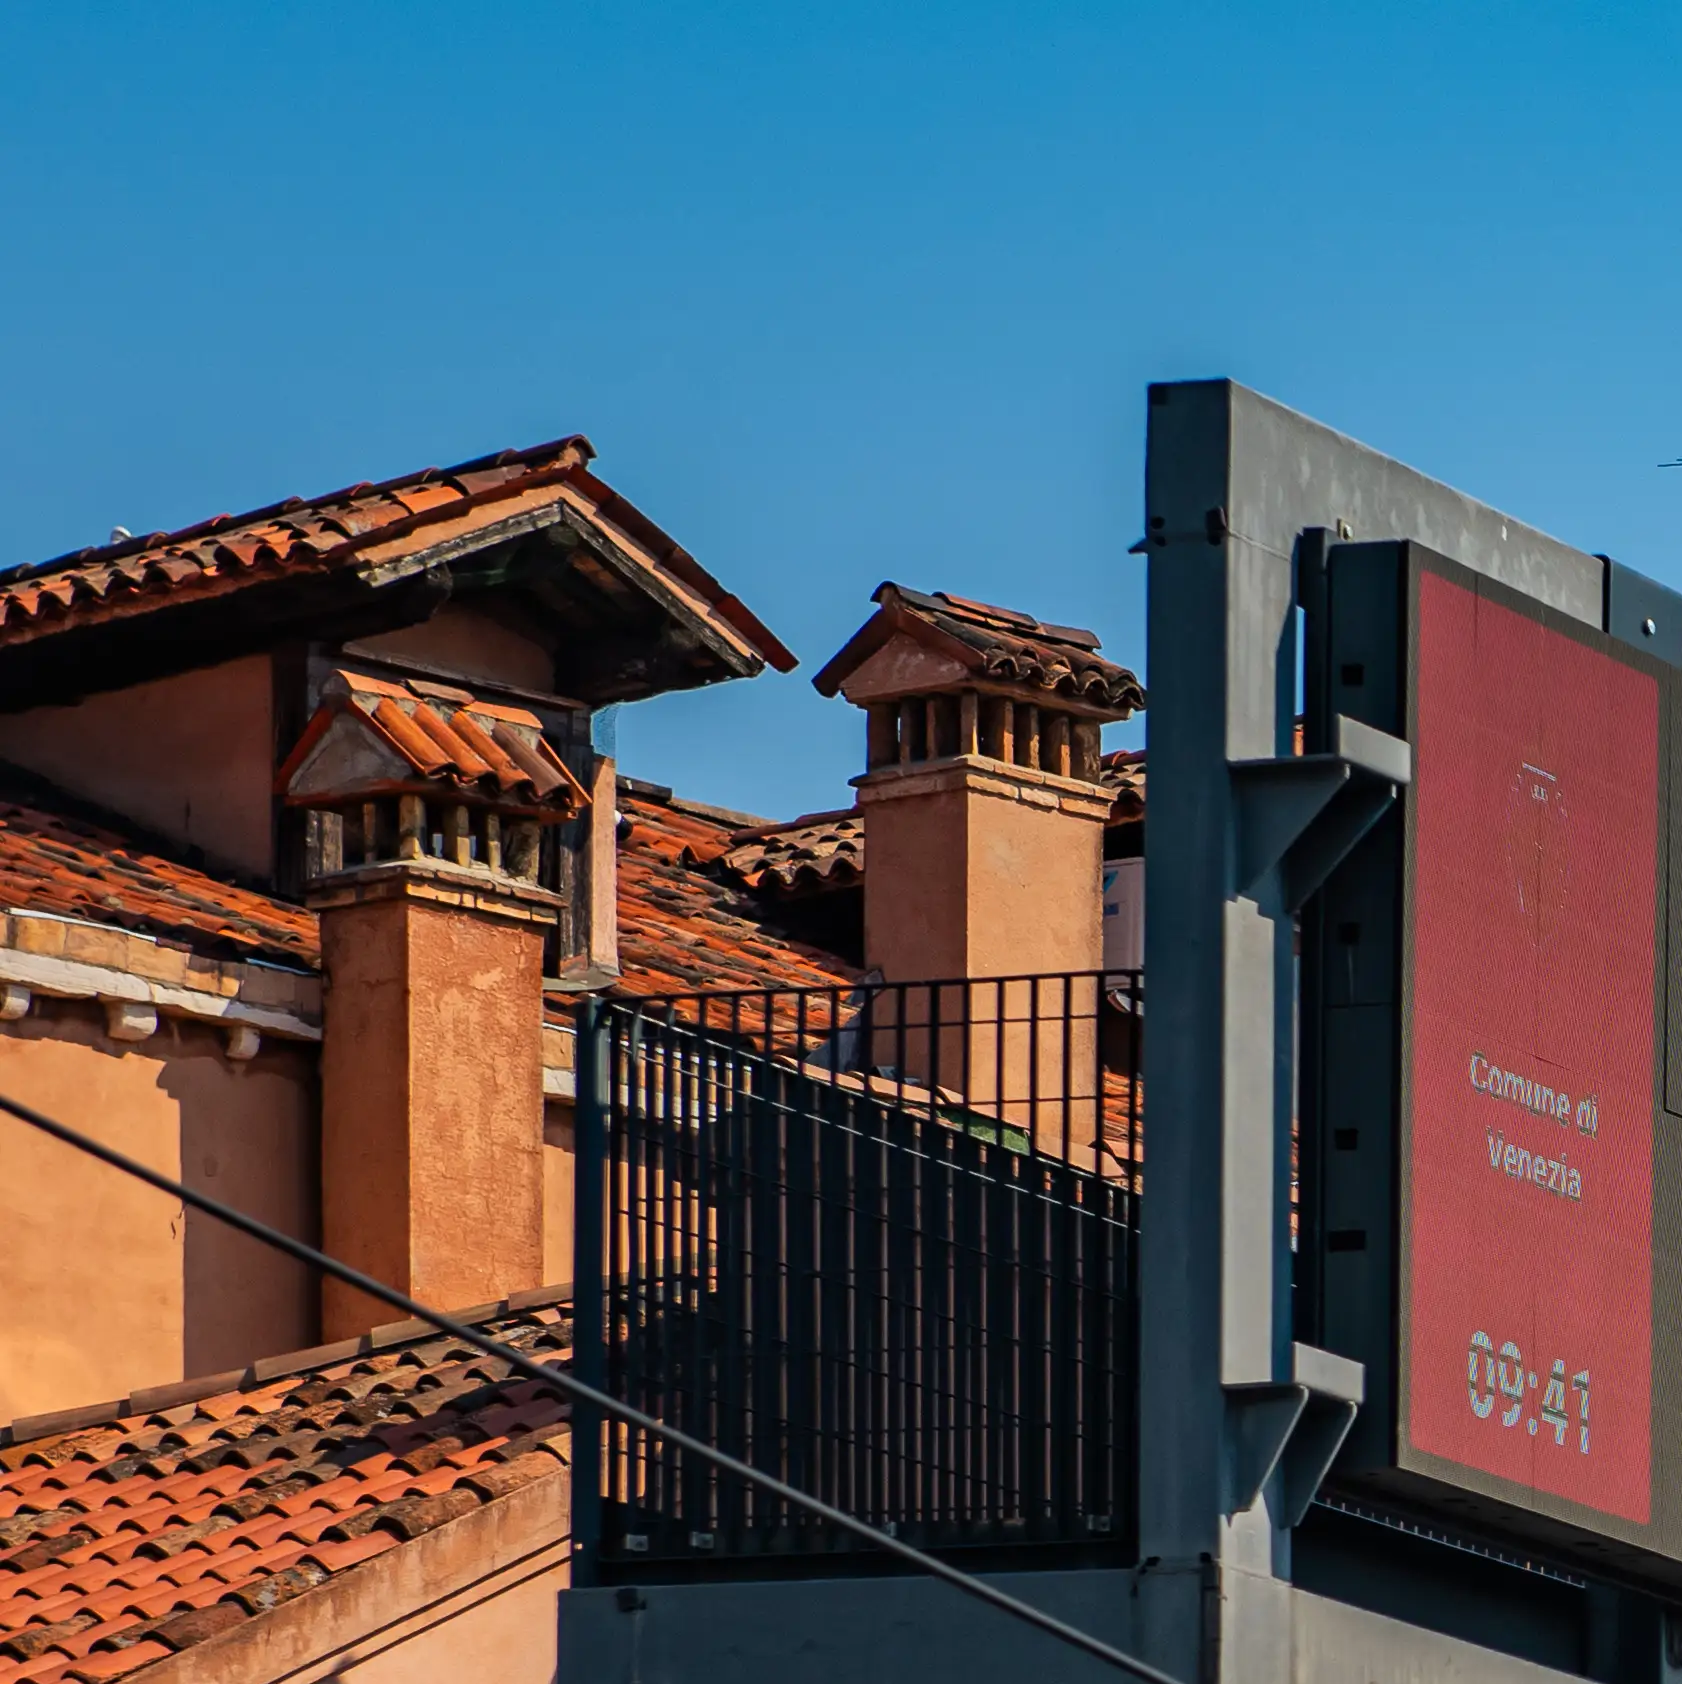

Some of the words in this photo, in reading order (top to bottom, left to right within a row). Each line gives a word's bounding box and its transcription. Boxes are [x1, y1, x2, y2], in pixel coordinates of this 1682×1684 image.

[1469, 1050, 1571, 1128] Comune
[1576, 1092, 1598, 1140] di
[1486, 1125, 1582, 1203] Venezia
[1468, 1330, 1590, 1454] 09:41
